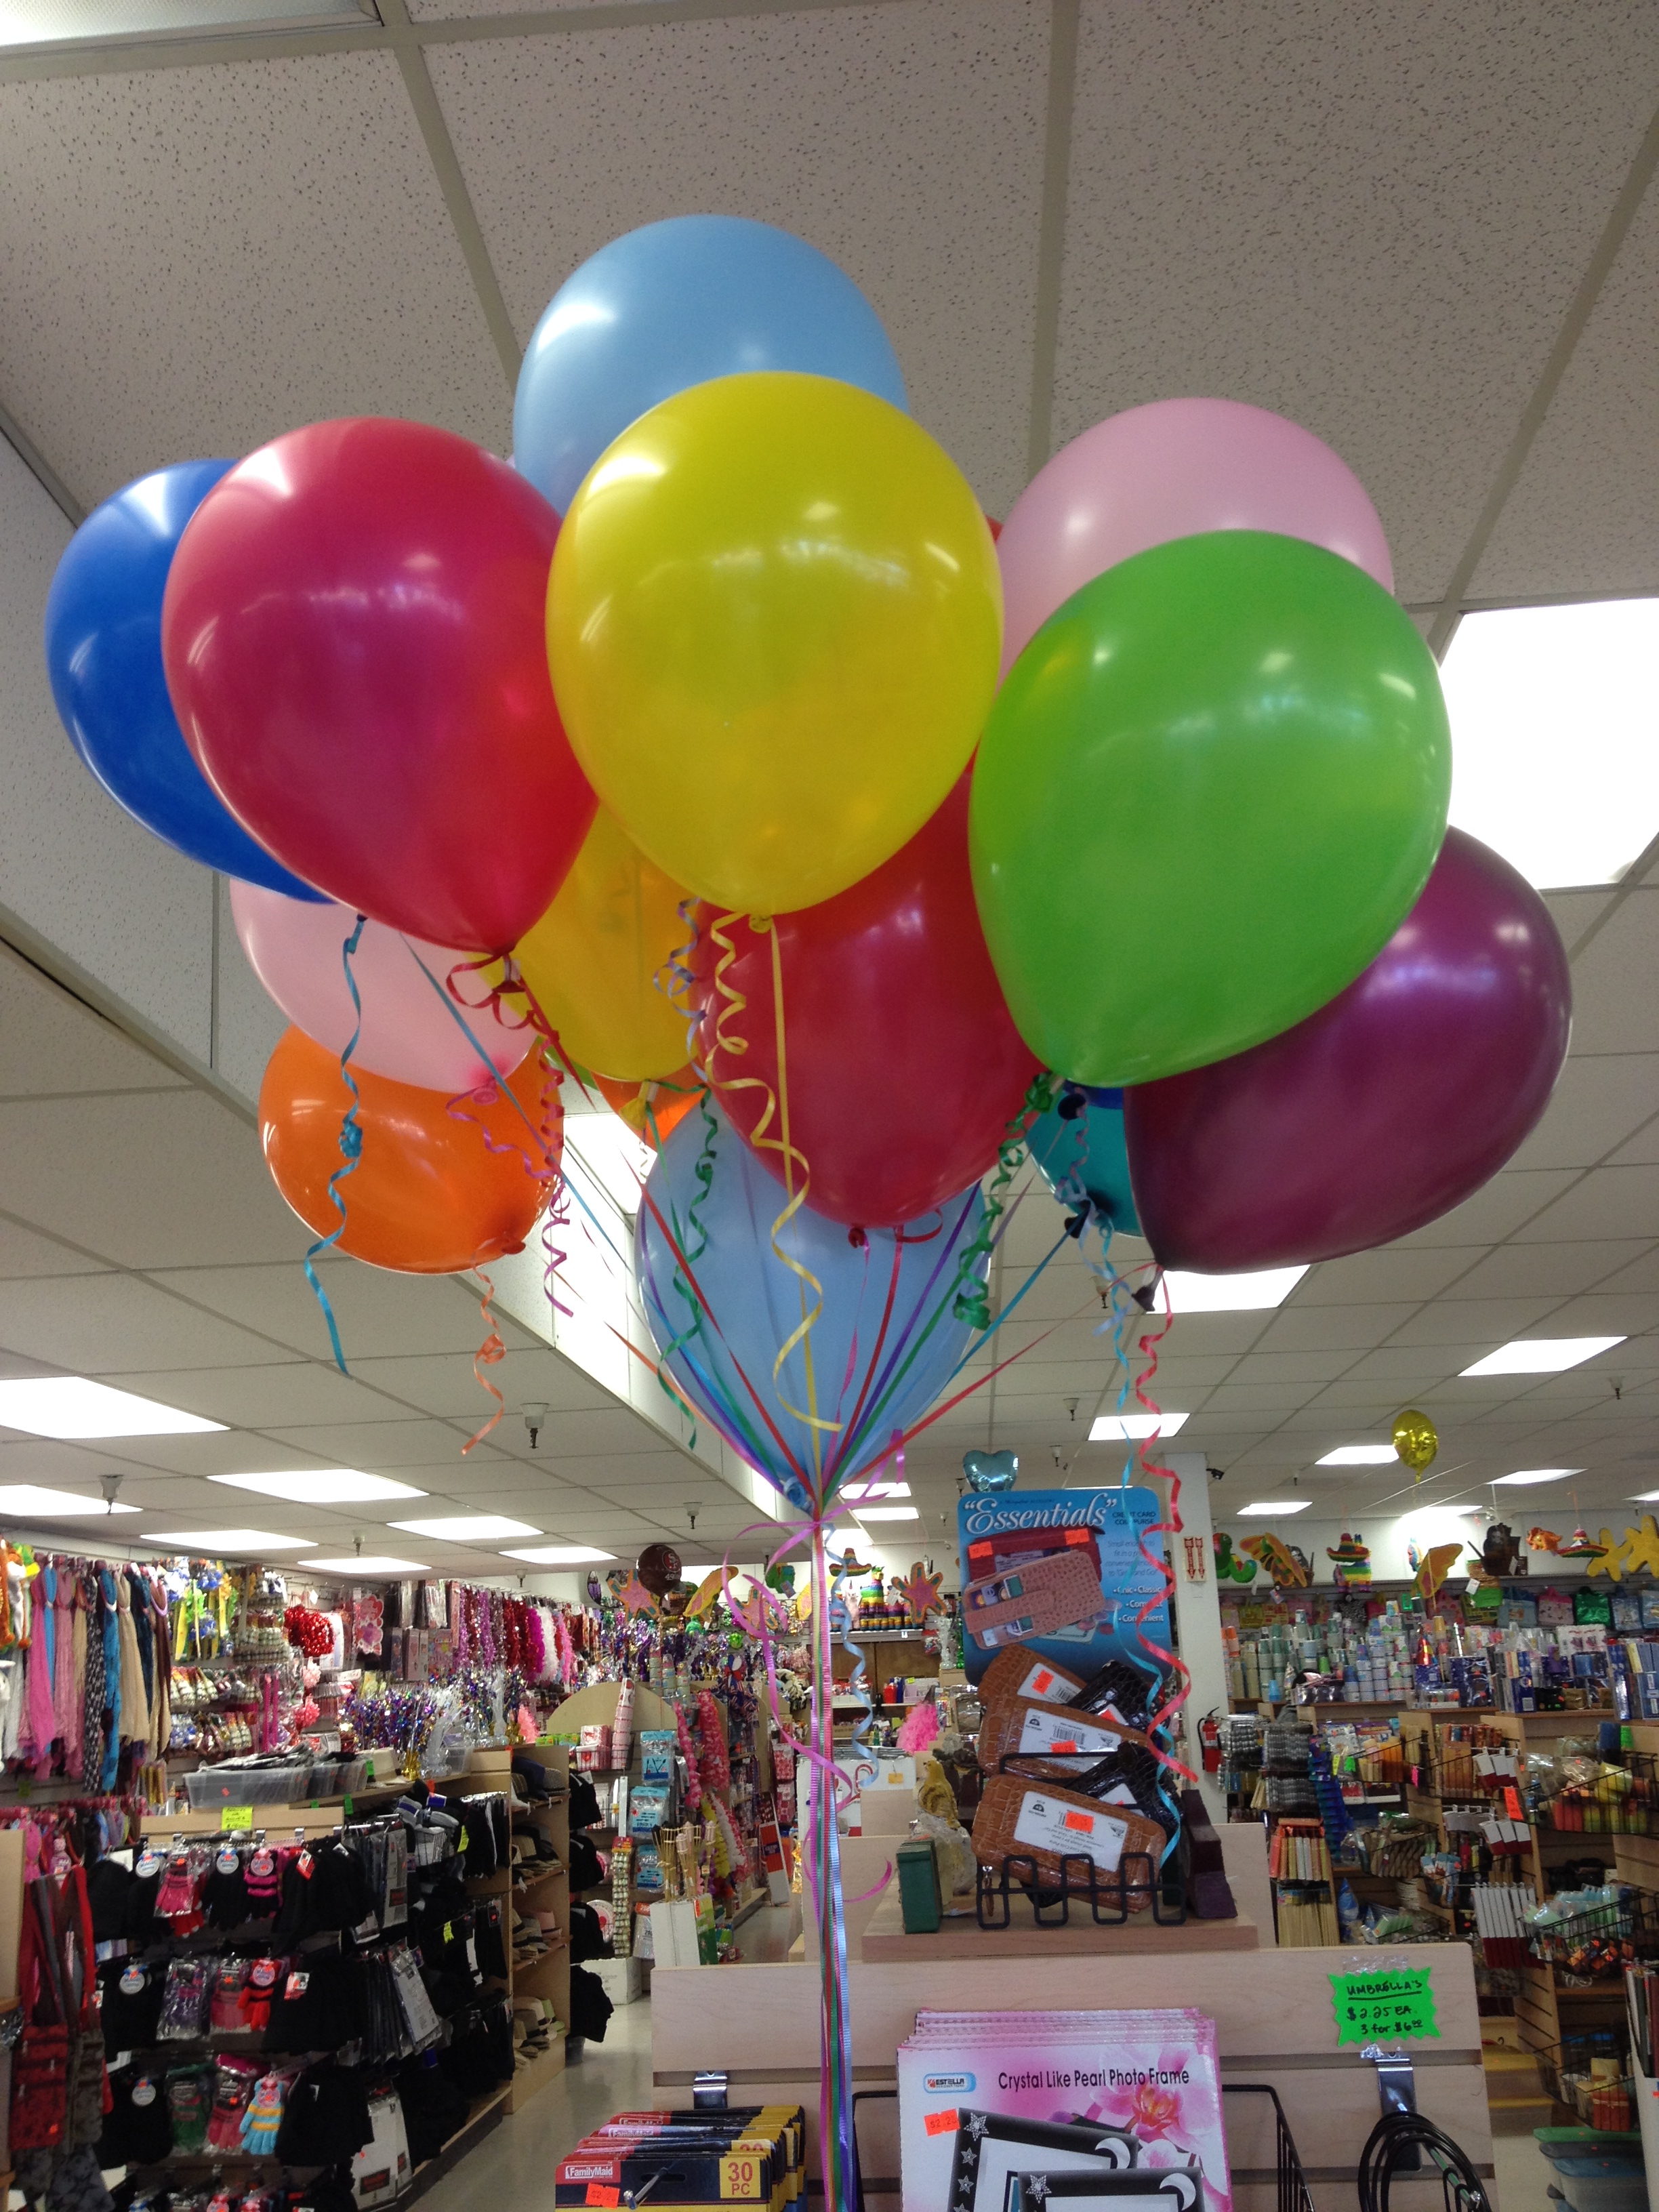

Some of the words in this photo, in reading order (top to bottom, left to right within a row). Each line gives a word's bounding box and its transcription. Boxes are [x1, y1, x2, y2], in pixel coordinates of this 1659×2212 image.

[1347, 1980, 1422, 1996] UMBRELLA'S
[1361, 2024, 1368, 2034] 3
[1372, 2023, 1391, 2034] for
[998, 2071, 1043, 2093] Crystal
[1046, 2070, 1071, 2088] Like
[1074, 2068, 1106, 2087] Pearl
[1109, 2068, 1145, 2086] Photo
[1149, 2068, 1190, 2085] Frame
[570, 2166, 613, 2178] FamilyMaid
[728, 2162, 754, 2183] 30
[731, 2183, 751, 2196] PC
